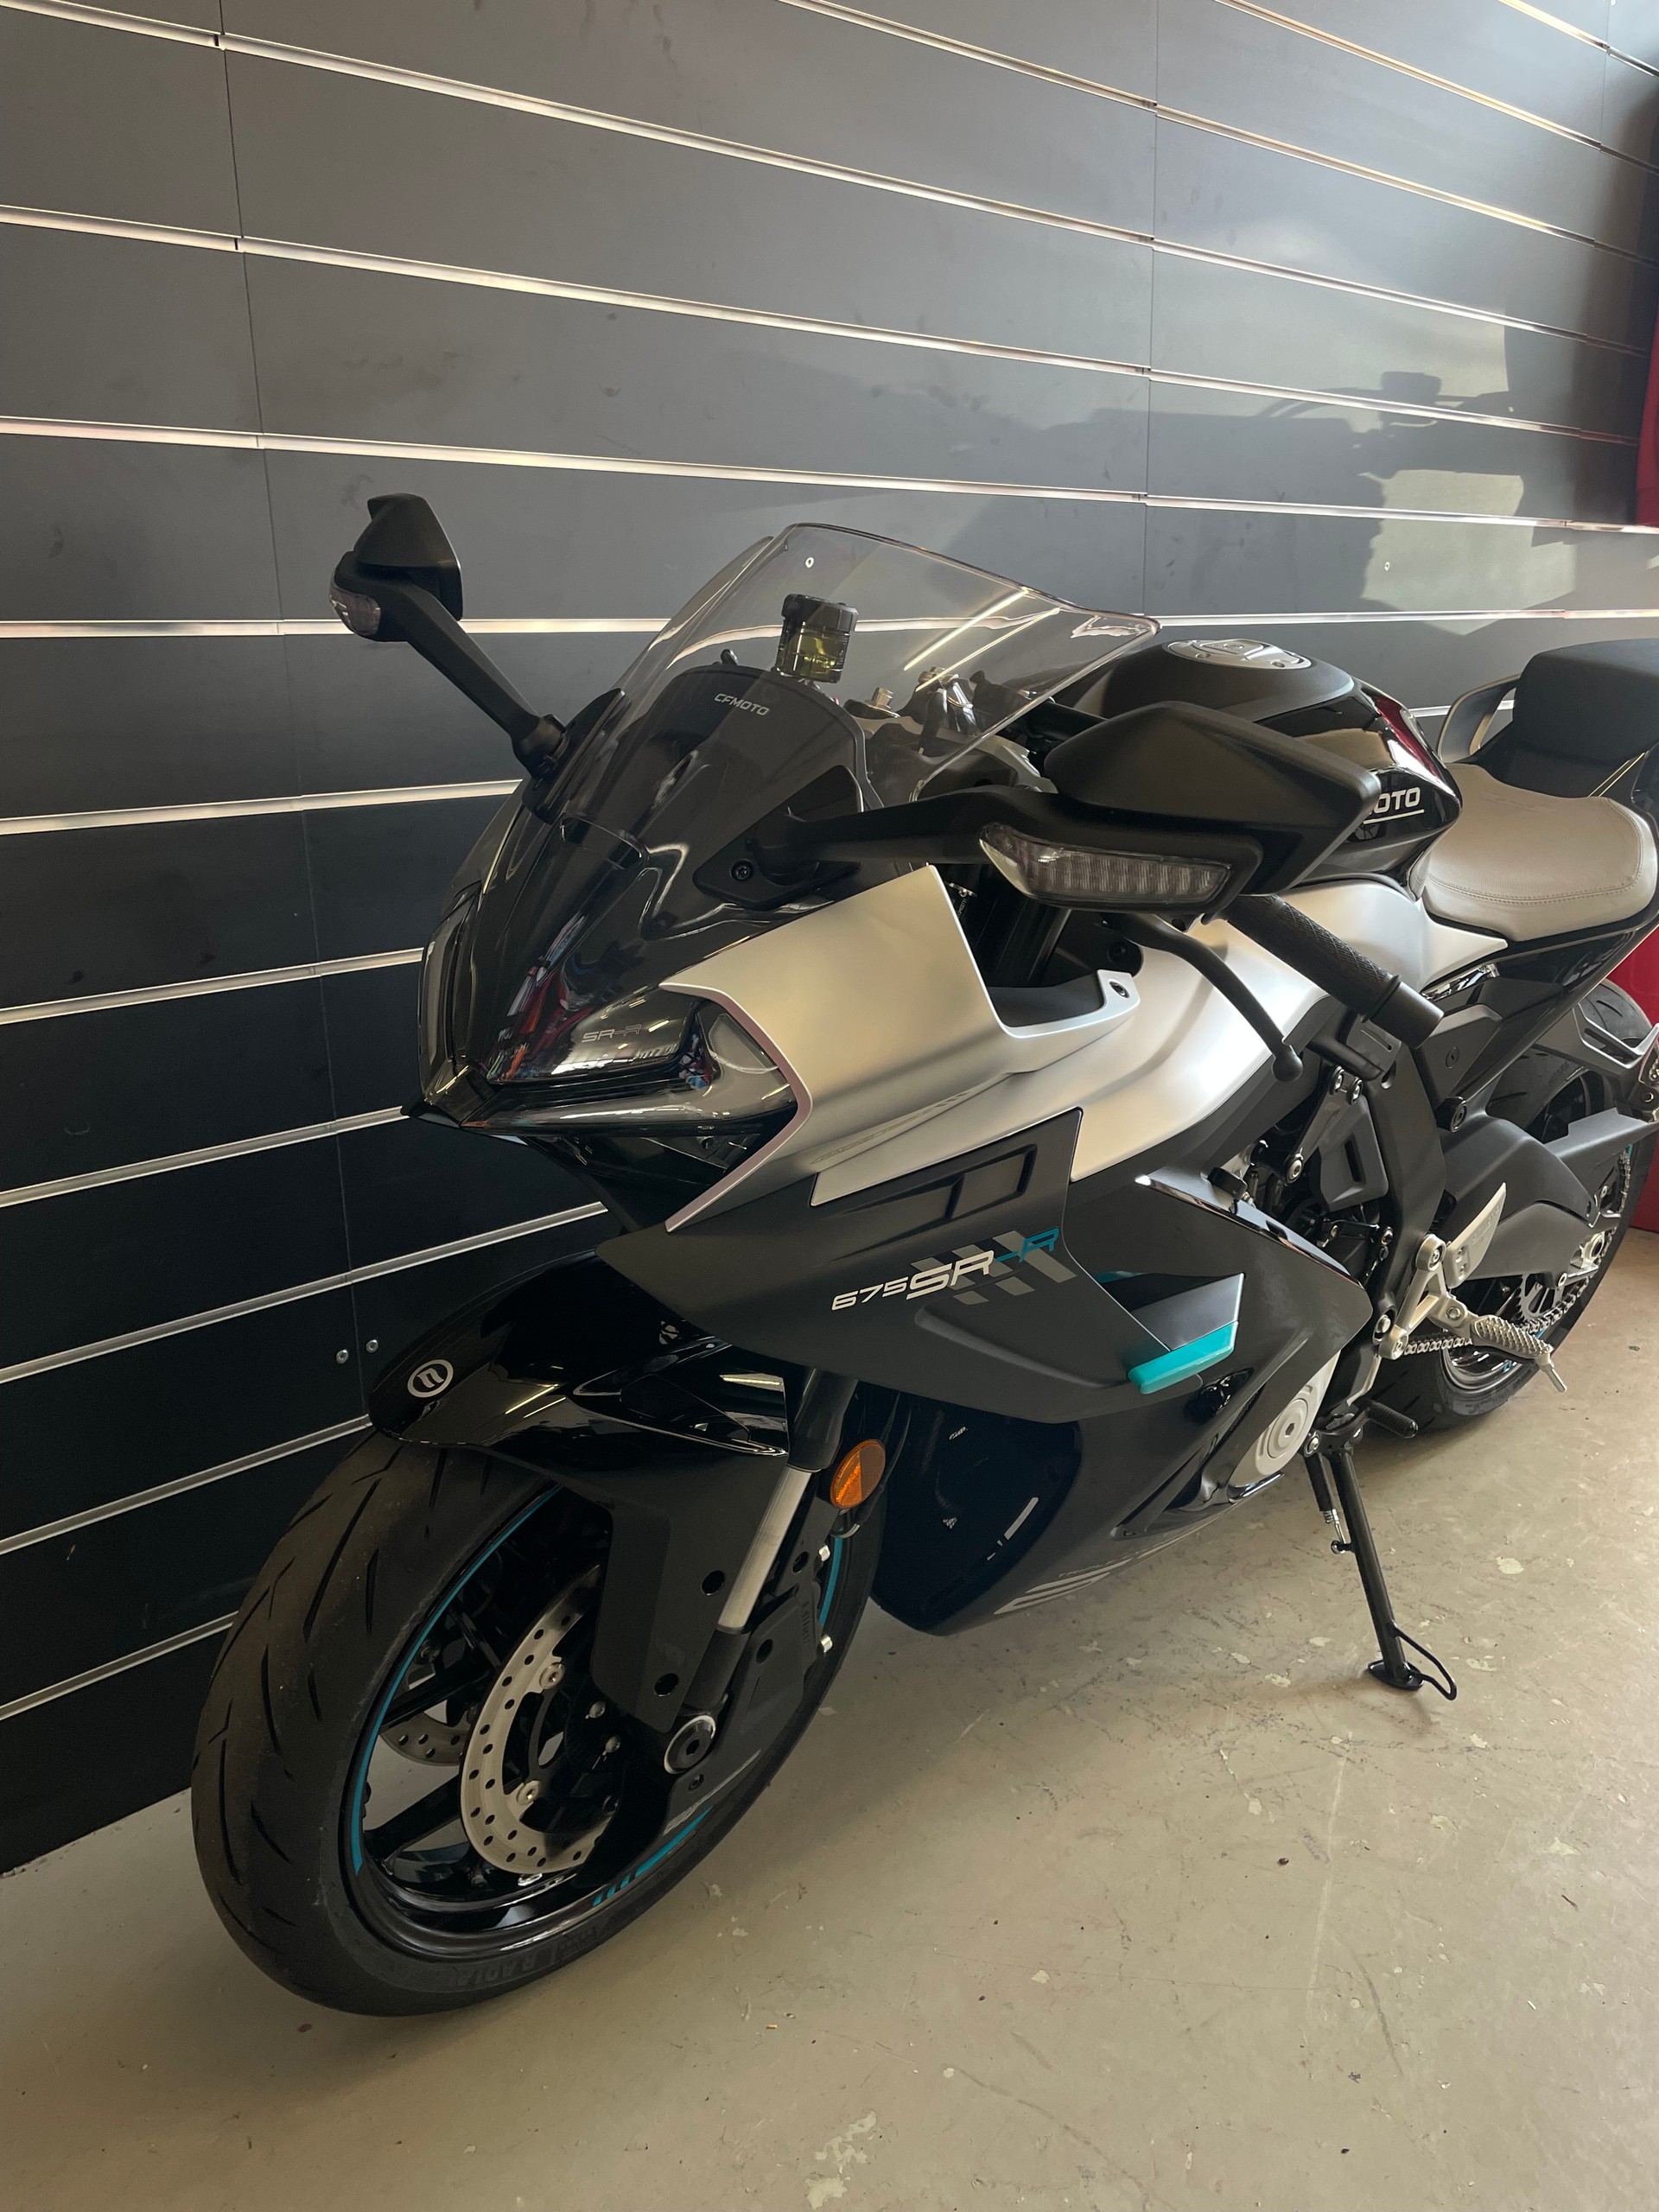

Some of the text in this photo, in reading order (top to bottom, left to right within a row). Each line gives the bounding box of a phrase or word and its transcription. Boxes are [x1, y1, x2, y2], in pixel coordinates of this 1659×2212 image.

[714, 693, 770, 716] CFMOTO
[1370, 786, 1421, 815] OTO
[582, 1024, 642, 1043] SR-R
